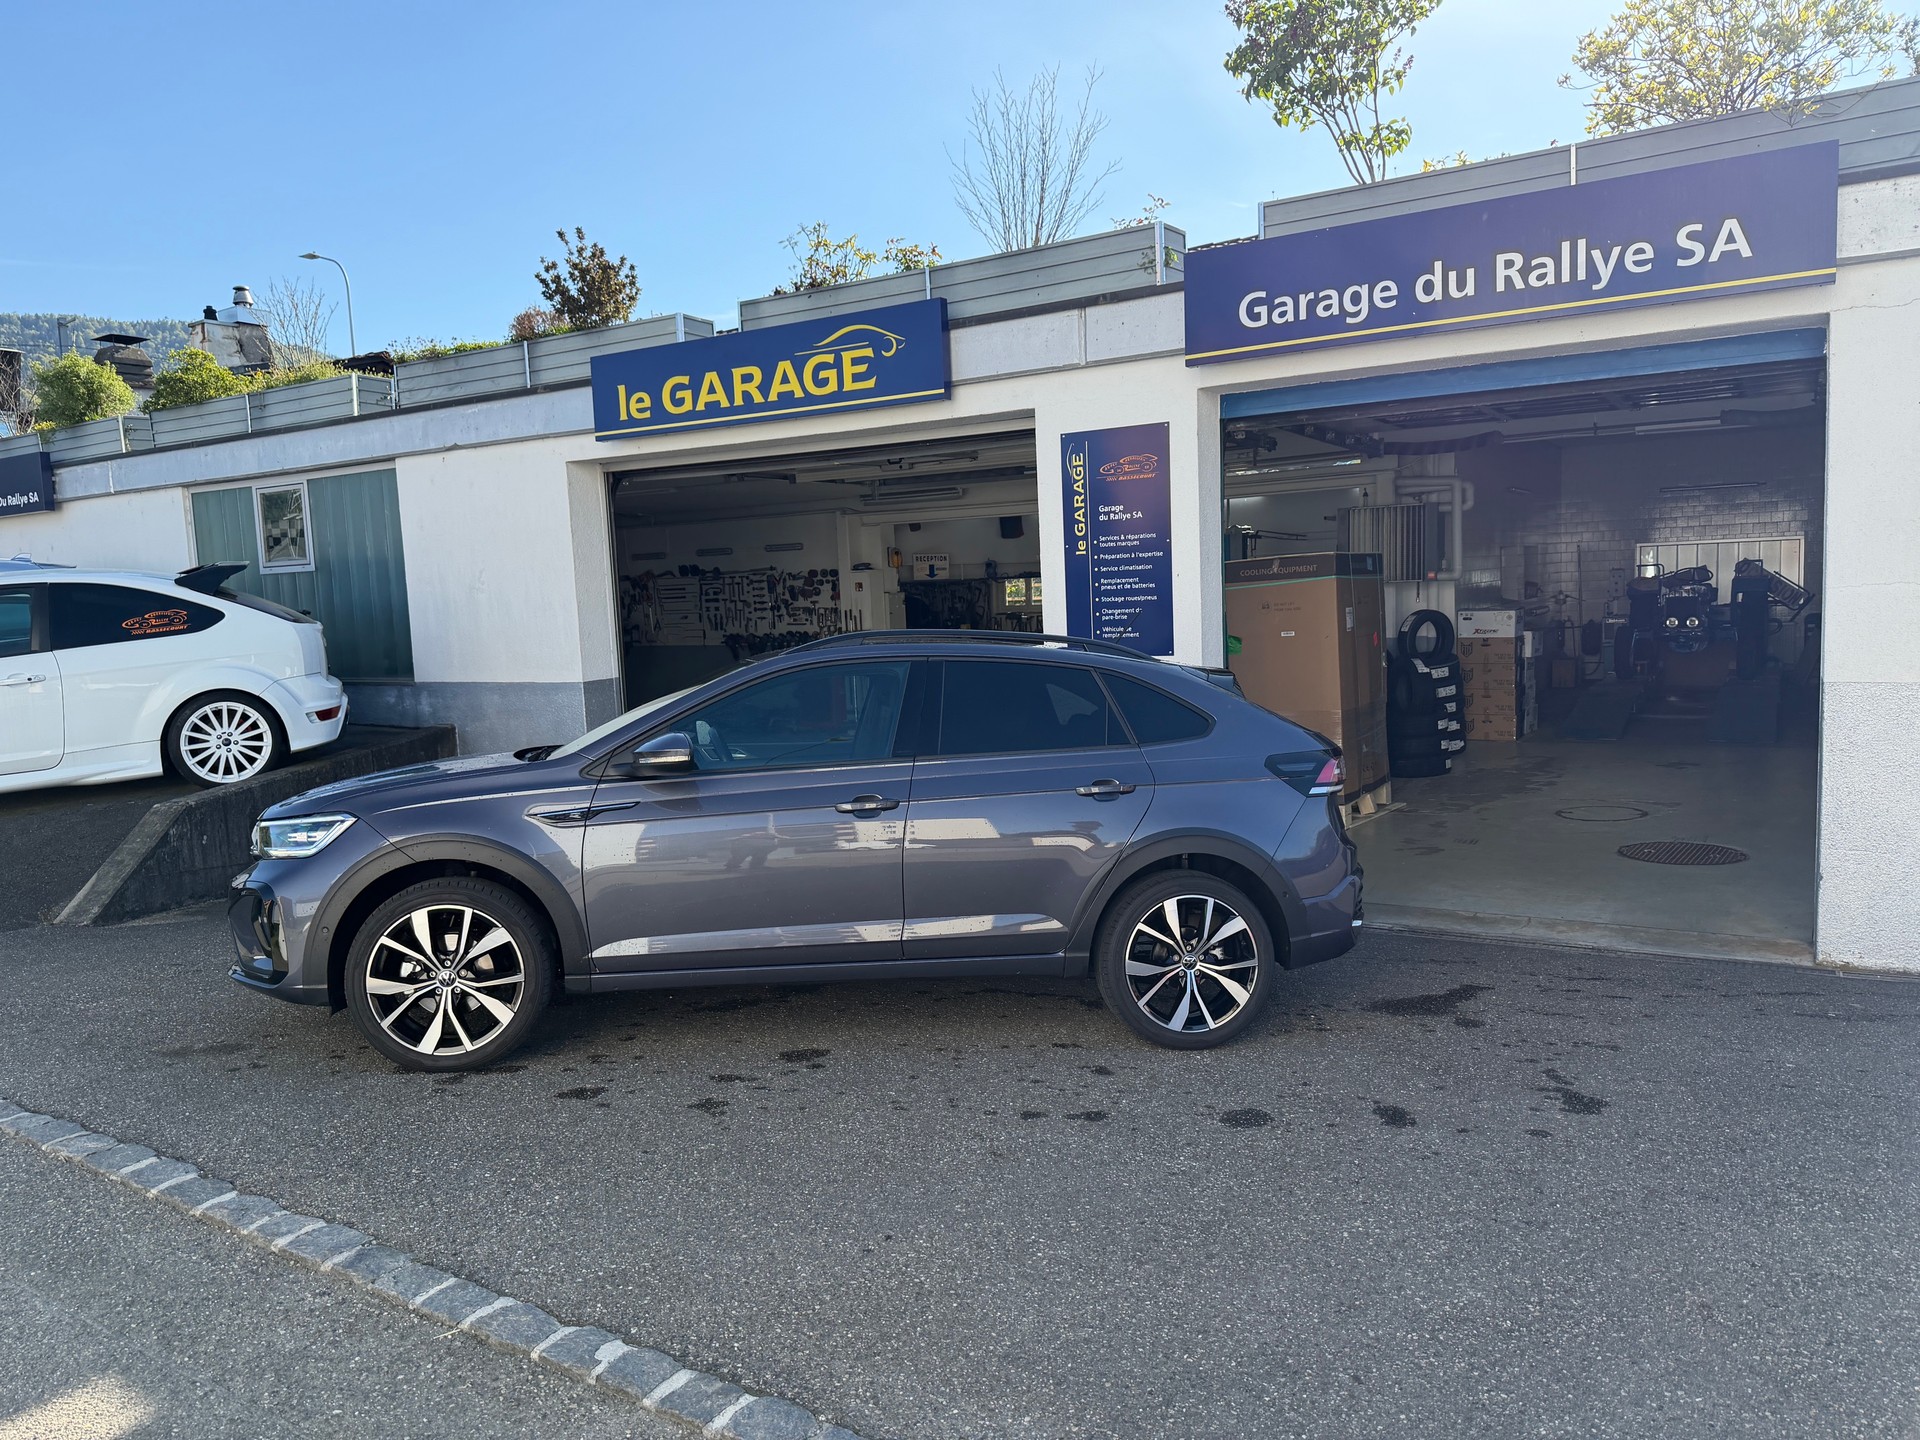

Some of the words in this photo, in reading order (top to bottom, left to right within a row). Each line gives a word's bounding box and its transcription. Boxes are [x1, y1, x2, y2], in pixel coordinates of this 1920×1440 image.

[1238, 279, 1397, 329] Garage
[1414, 259, 1476, 304] du
[1494, 238, 1654, 292] Rallye
[1675, 218, 1753, 268] SA
[616, 384, 651, 421] le
[661, 347, 877, 415] GARAGE
[7, 492, 28, 508] Rallye
[28, 491, 39, 503] SA
[1072, 453, 1087, 537] GARAGE
[1098, 504, 1124, 512] Garage
[1110, 512, 1131, 520] Rallye
[1126, 532, 1156, 540] réparations
[1076, 540, 1087, 555] le
[1240, 568, 1273, 576] COOLING
